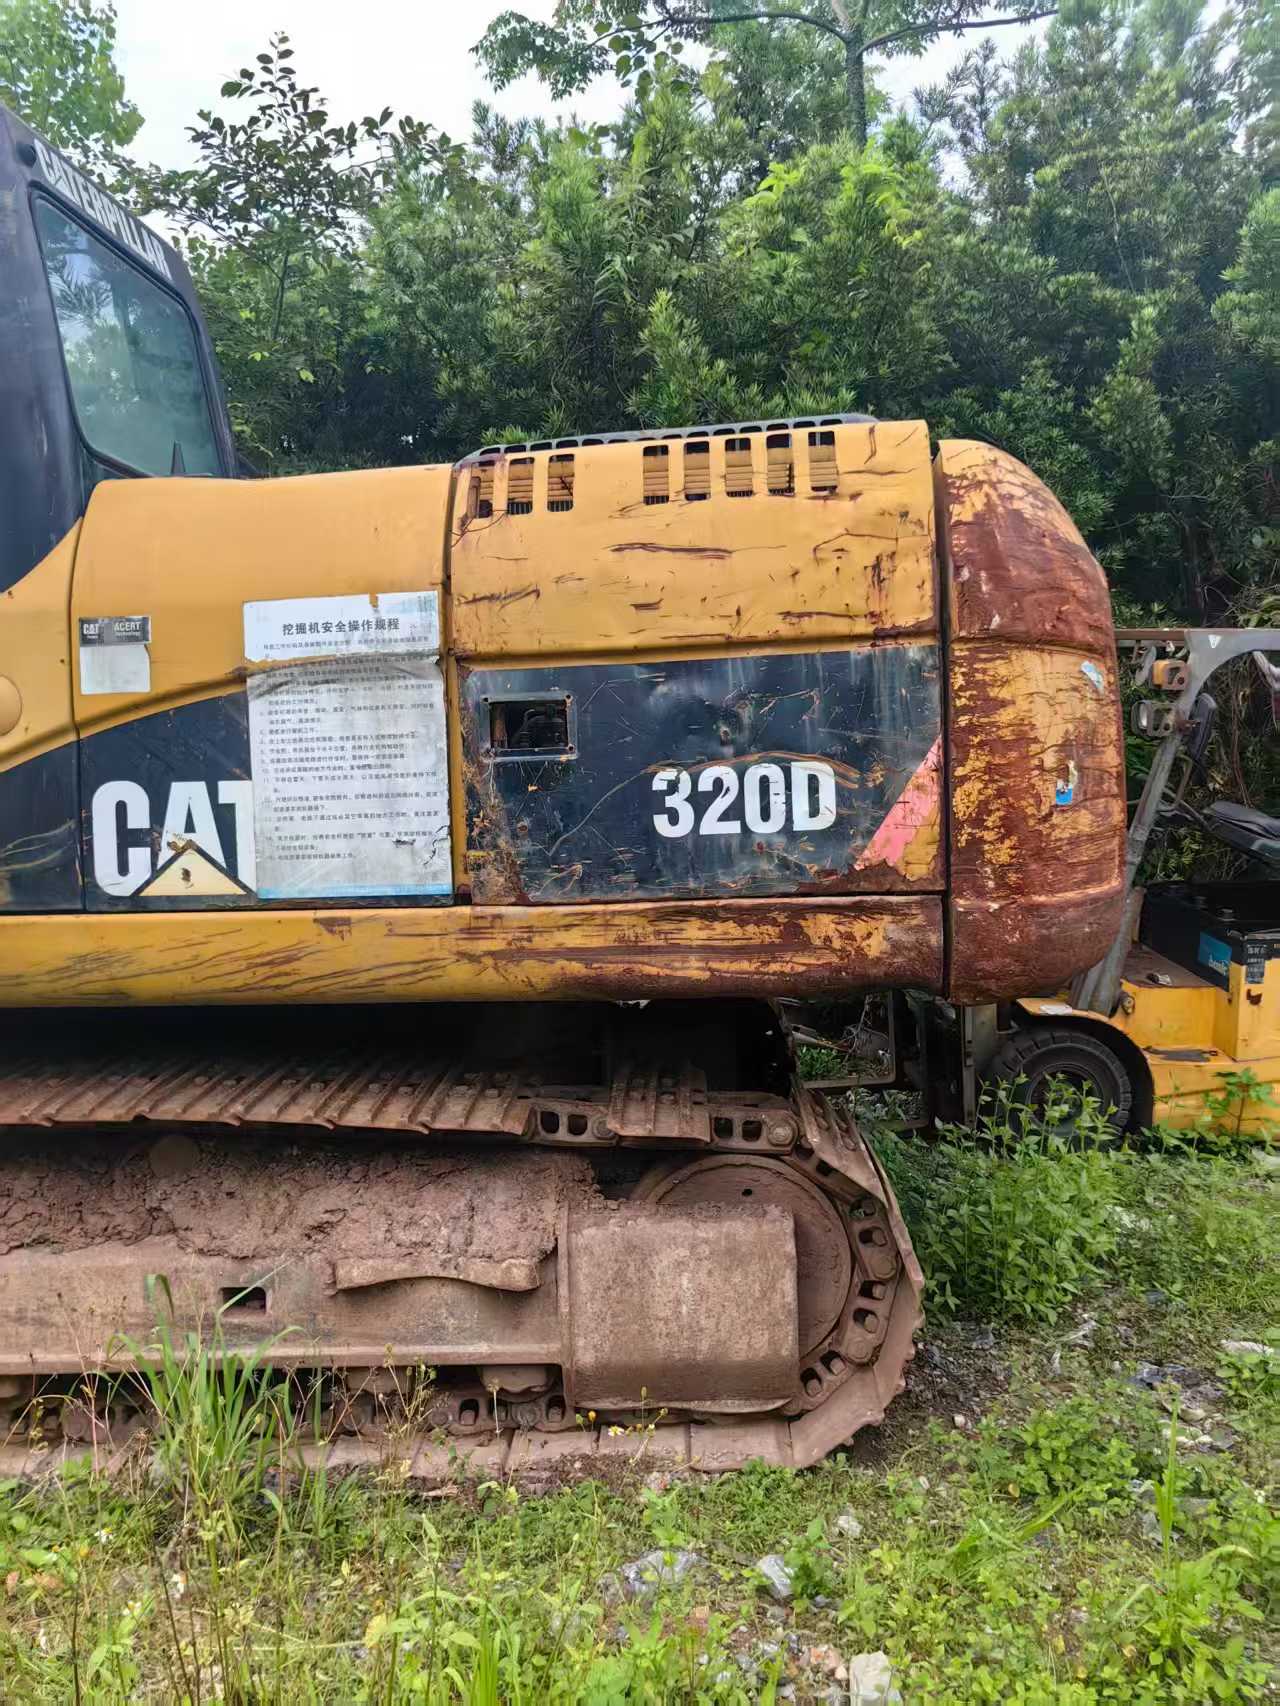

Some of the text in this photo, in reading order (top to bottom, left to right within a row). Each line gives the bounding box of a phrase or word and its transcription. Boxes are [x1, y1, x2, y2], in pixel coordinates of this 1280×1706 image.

[83, 623, 99, 635] CAT
[114, 621, 142, 632] ACERT
[282, 617, 400, 636] 挖掘机安全操作规程
[652, 761, 836, 838] 320D
[92, 780, 257, 896] CAT
